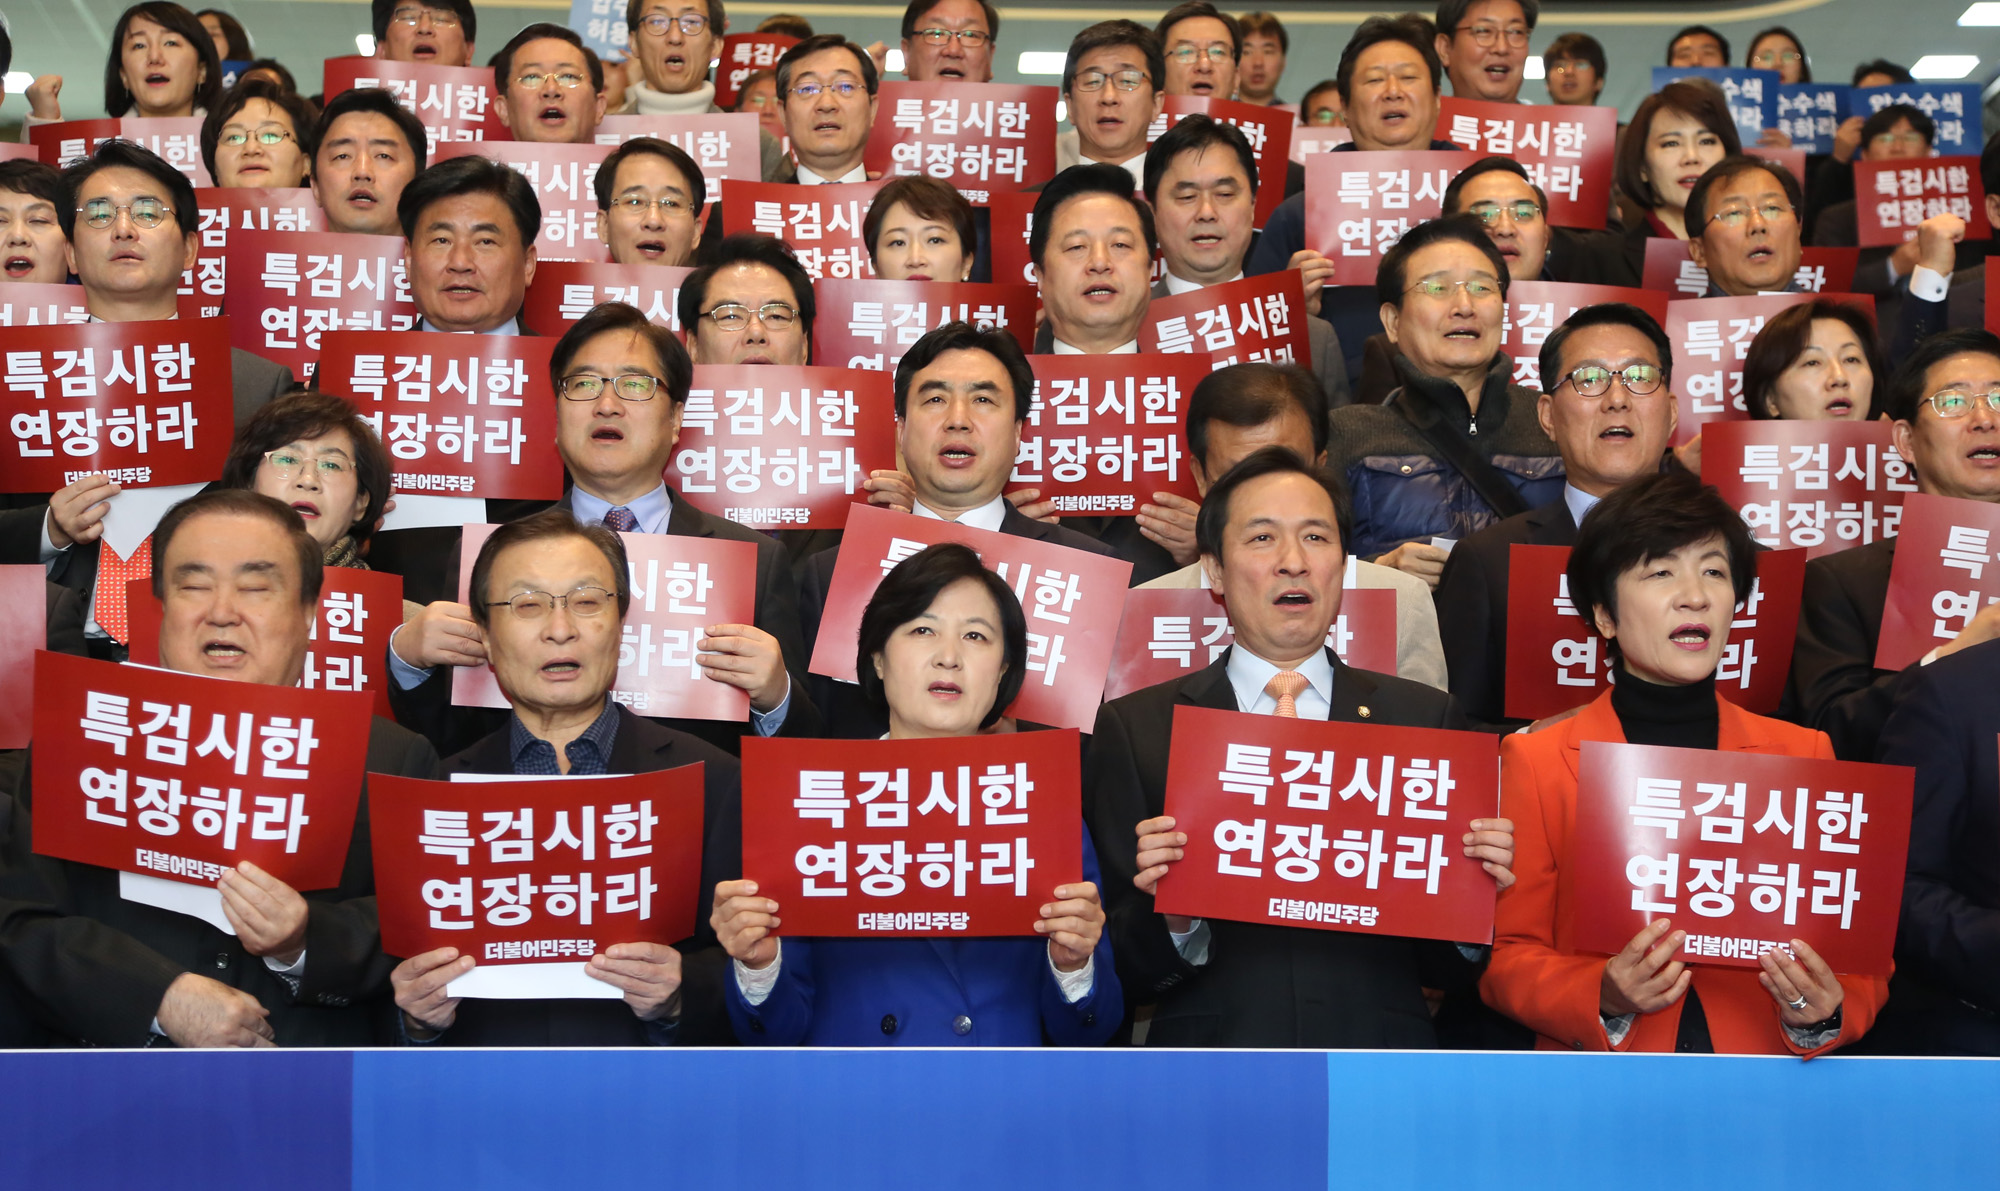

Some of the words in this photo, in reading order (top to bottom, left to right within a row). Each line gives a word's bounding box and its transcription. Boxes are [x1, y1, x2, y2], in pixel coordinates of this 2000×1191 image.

[893, 99, 1031, 138] 특검시한
[1449, 114, 1587, 158] 특검시한
[891, 140, 1028, 183] 연장하라
[1875, 165, 1970, 197] 특검시한
[1337, 169, 1463, 209] 특검시
[752, 200, 874, 240] 특검시
[1156, 292, 1290, 353] 특검시한
[4, 343, 195, 399] 특검시한
[350, 354, 529, 407] 특검시한
[10, 401, 198, 458] 연장하라
[681, 388, 859, 437] 특검시한
[391, 472, 476, 491] 더불어민주당
[676, 446, 860, 495] 연장하라
[725, 508, 811, 525] 더불어민주당
[1051, 496, 1135, 512] 더불어민주당
[80, 690, 320, 780] 특검시한
[793, 762, 1034, 828] 특검시한
[1218, 743, 1456, 821] 특검시한
[79, 767, 310, 854] 연장하라
[418, 800, 659, 865] 특검시한
[1628, 777, 1869, 854] 특검시한
[794, 837, 1035, 897] 연장하라
[1213, 818, 1448, 895] 연장하라
[421, 866, 658, 930] 연장하라
[1268, 897, 1380, 927] 더불어민주당
[1625, 853, 1861, 930] 연장하라
[858, 912, 970, 931] 더불어민주당
[485, 938, 597, 960] 더불어민주당
